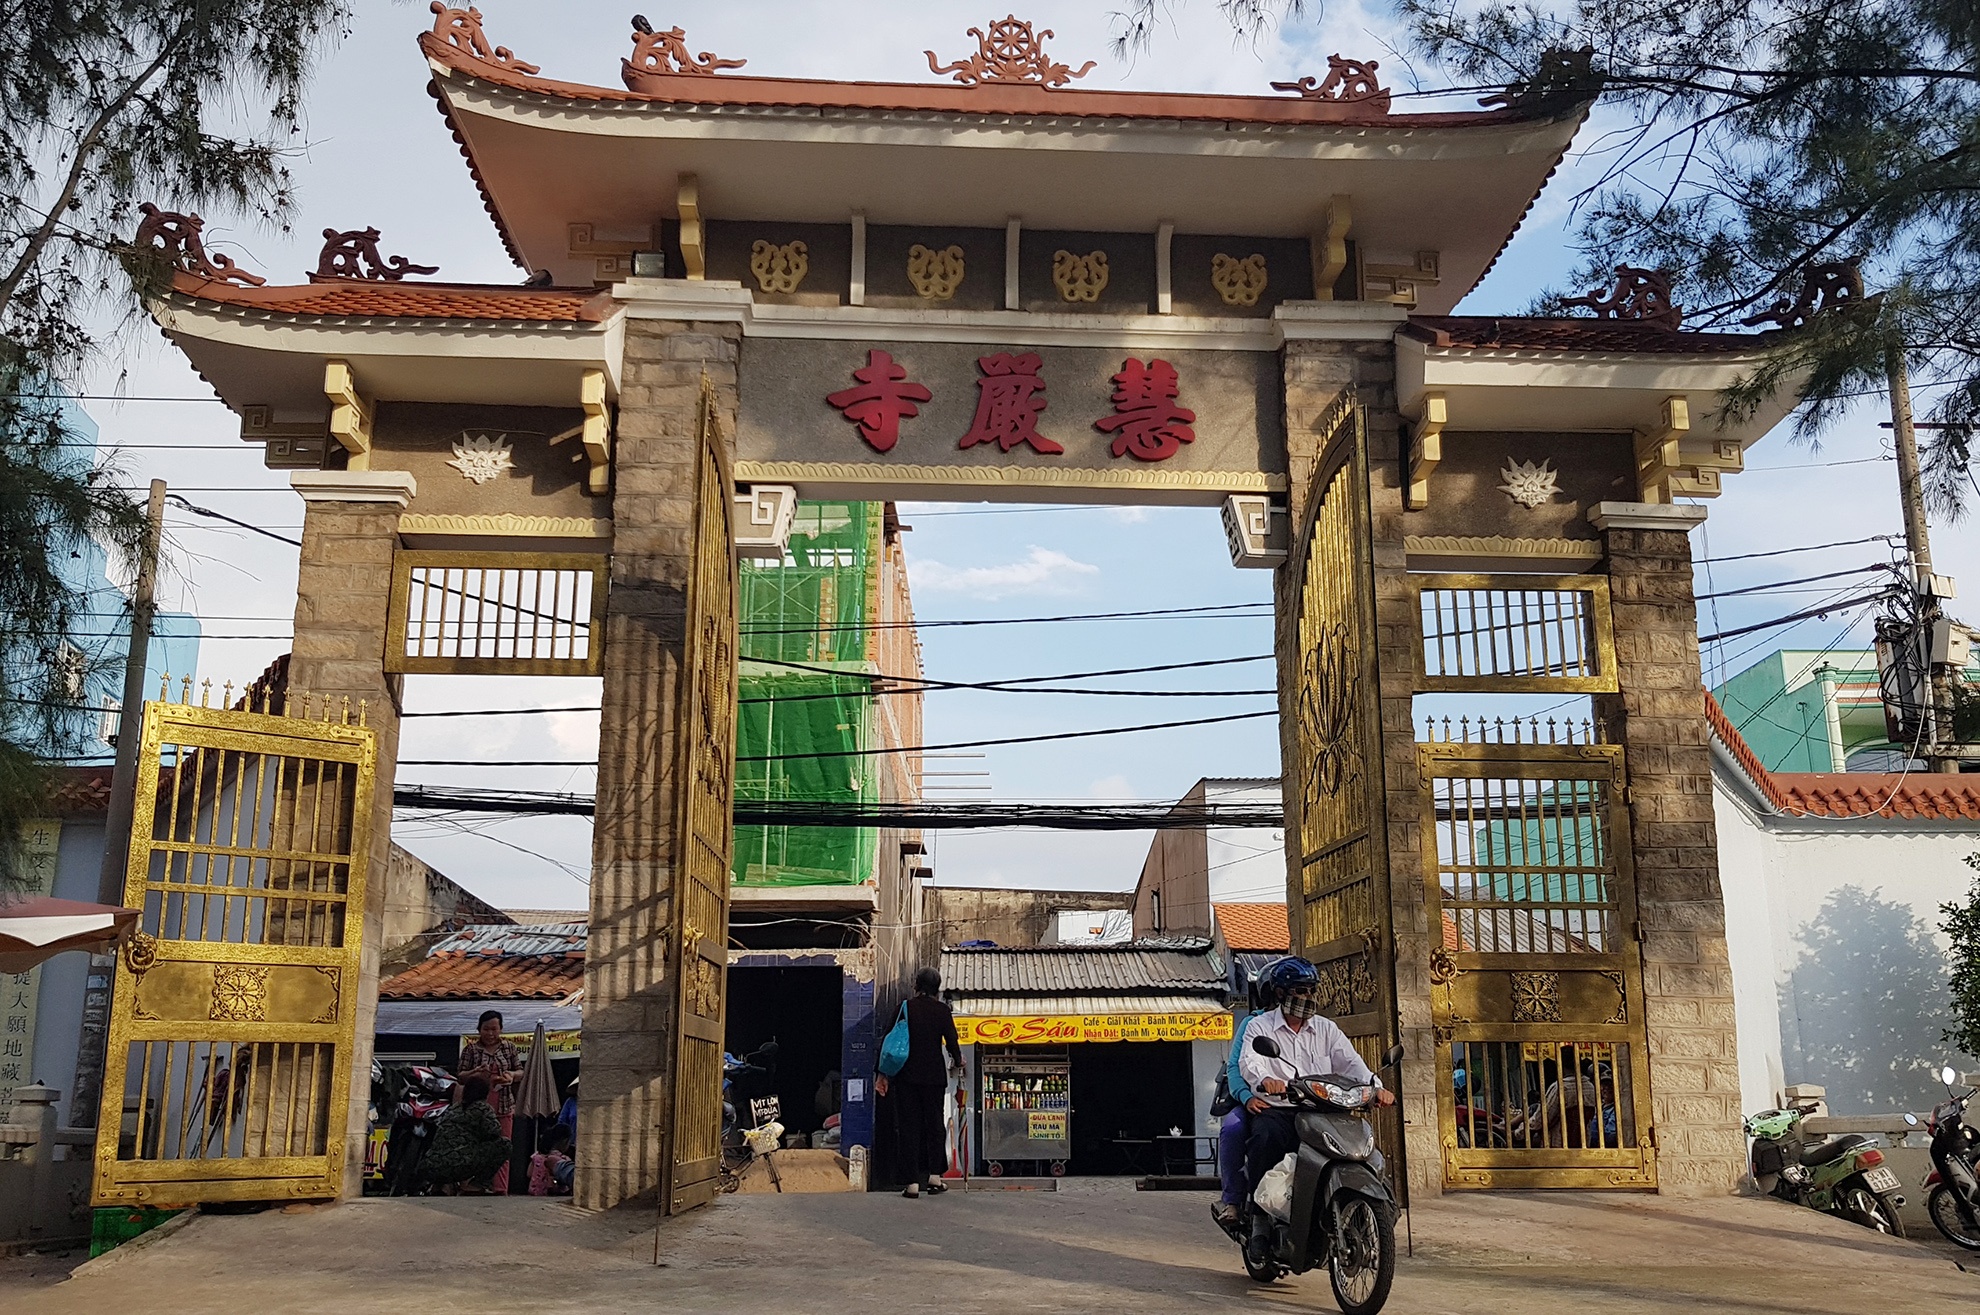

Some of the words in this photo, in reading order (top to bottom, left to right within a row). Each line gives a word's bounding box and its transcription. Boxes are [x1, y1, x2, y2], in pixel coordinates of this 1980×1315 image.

[1083, 1016, 1100, 1026] Café
[1123, 1016, 1140, 1025] Khát
[1147, 1015, 1165, 1025] Bánh
[1179, 1015, 1196, 1027] Chay
[975, 1019, 1016, 1039] Cô
[1015, 1018, 1079, 1041] Sáu
[1121, 1028, 1139, 1038] Bánh
[1169, 1027, 1187, 1038] Chay
